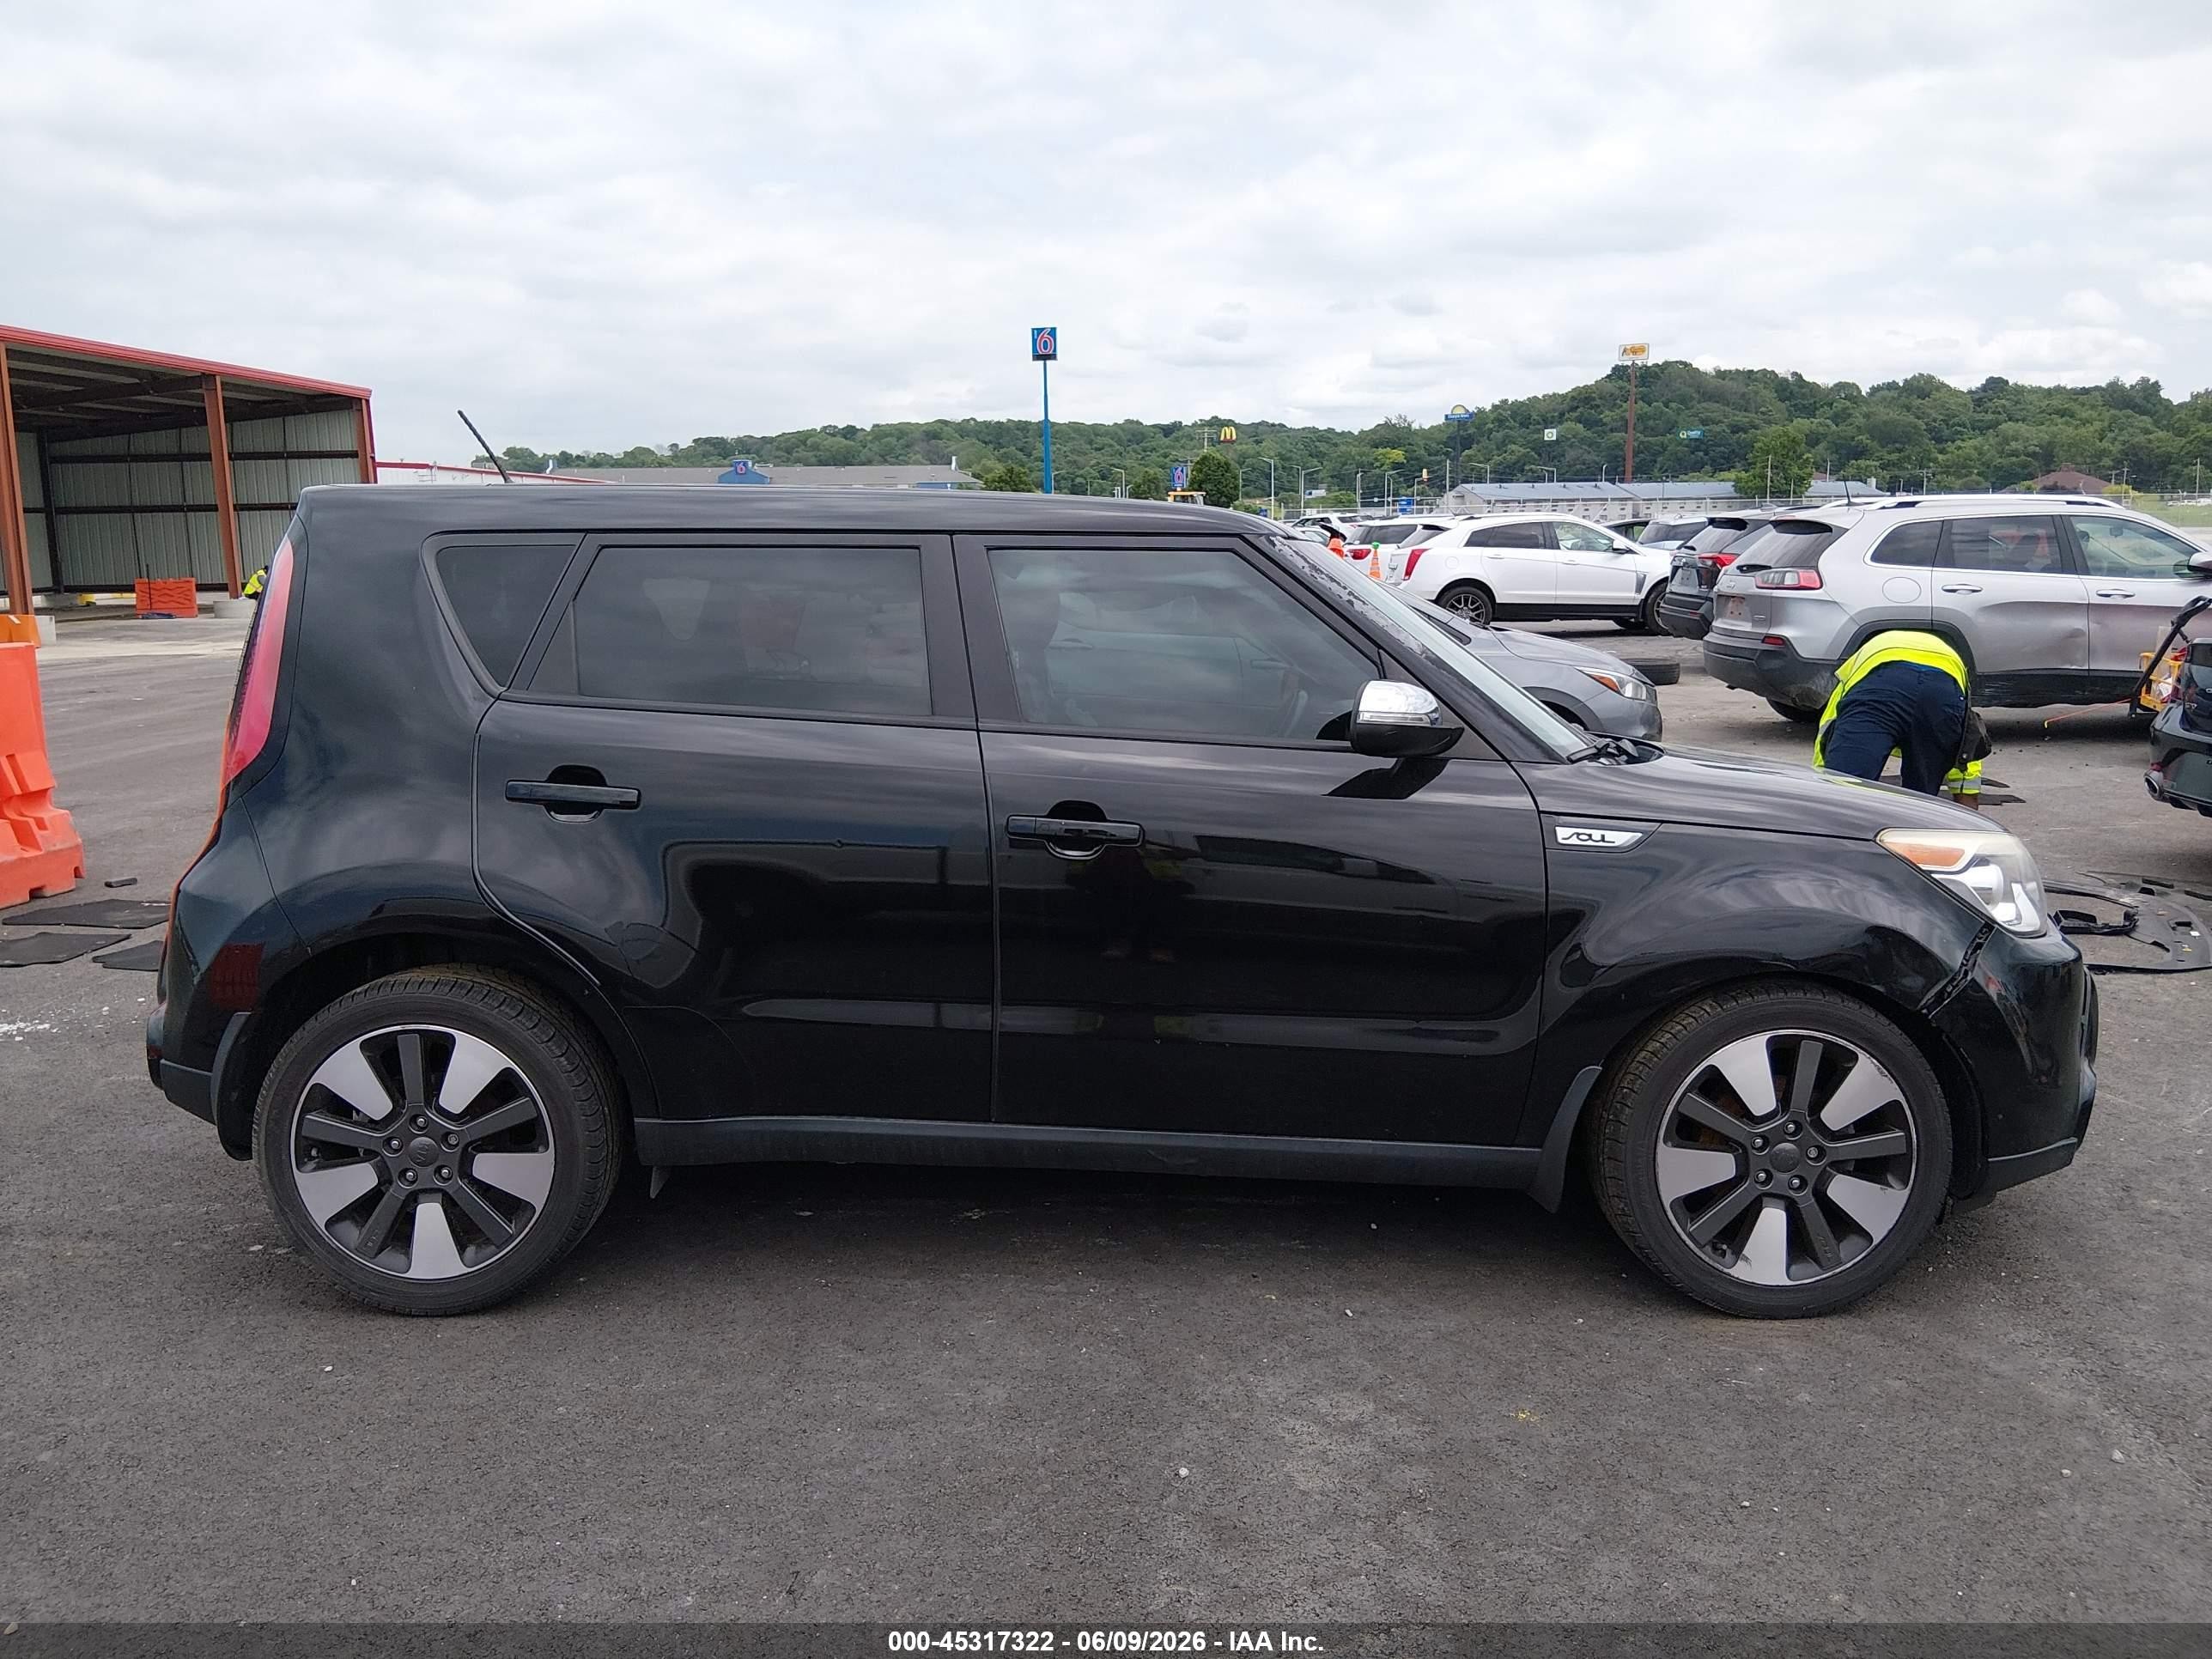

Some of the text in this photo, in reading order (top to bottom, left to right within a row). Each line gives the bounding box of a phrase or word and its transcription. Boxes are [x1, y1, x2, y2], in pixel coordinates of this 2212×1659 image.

[1036, 328, 1054, 355] 6
[736, 462, 746, 474] 6
[1174, 467, 1184, 484] 6
[1561, 831, 1616, 844] SOUL
